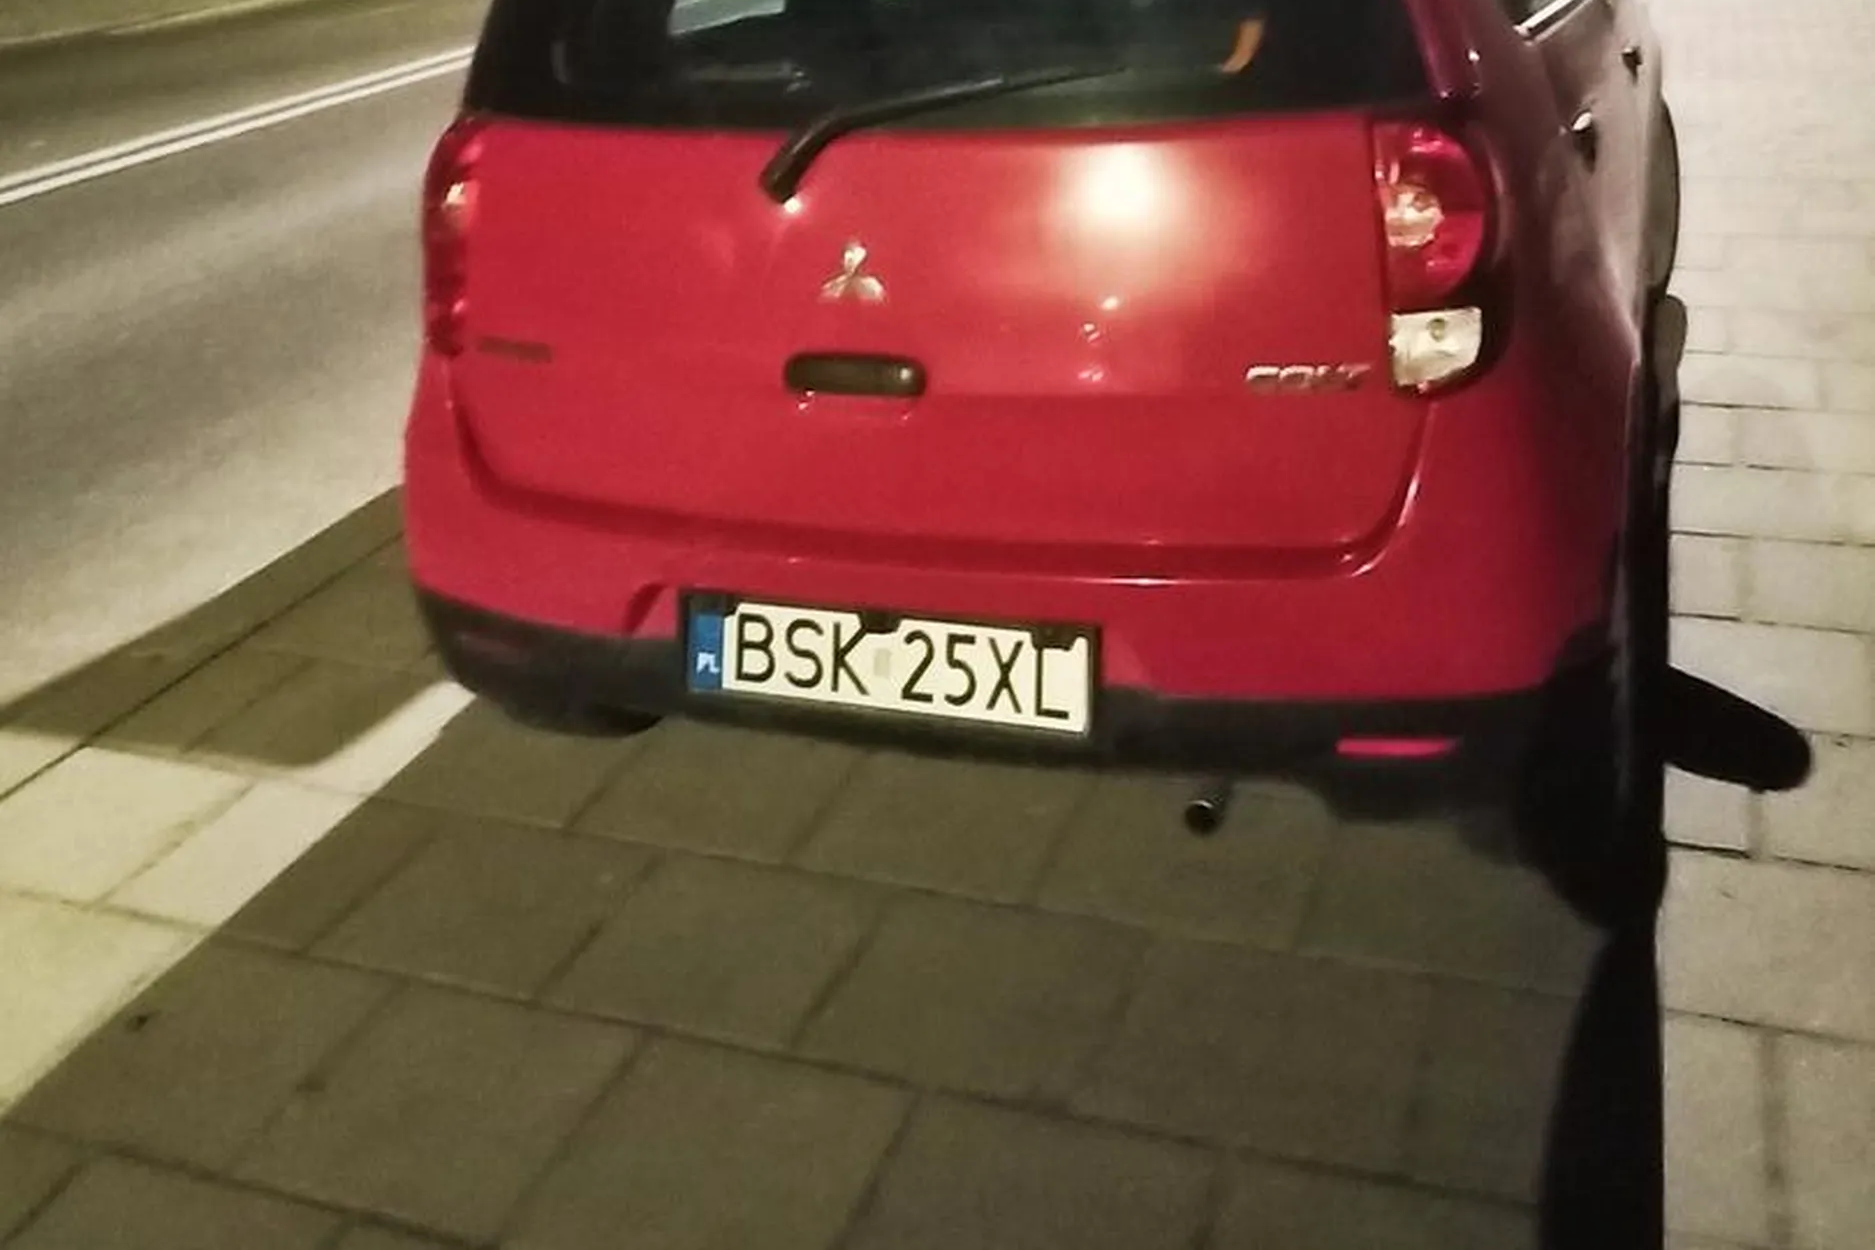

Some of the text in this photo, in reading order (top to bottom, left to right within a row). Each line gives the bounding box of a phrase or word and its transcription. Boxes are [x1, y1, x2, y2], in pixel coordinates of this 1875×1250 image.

[697, 653, 720, 673] PL
[736, 613, 1070, 719] BSK 25XL
